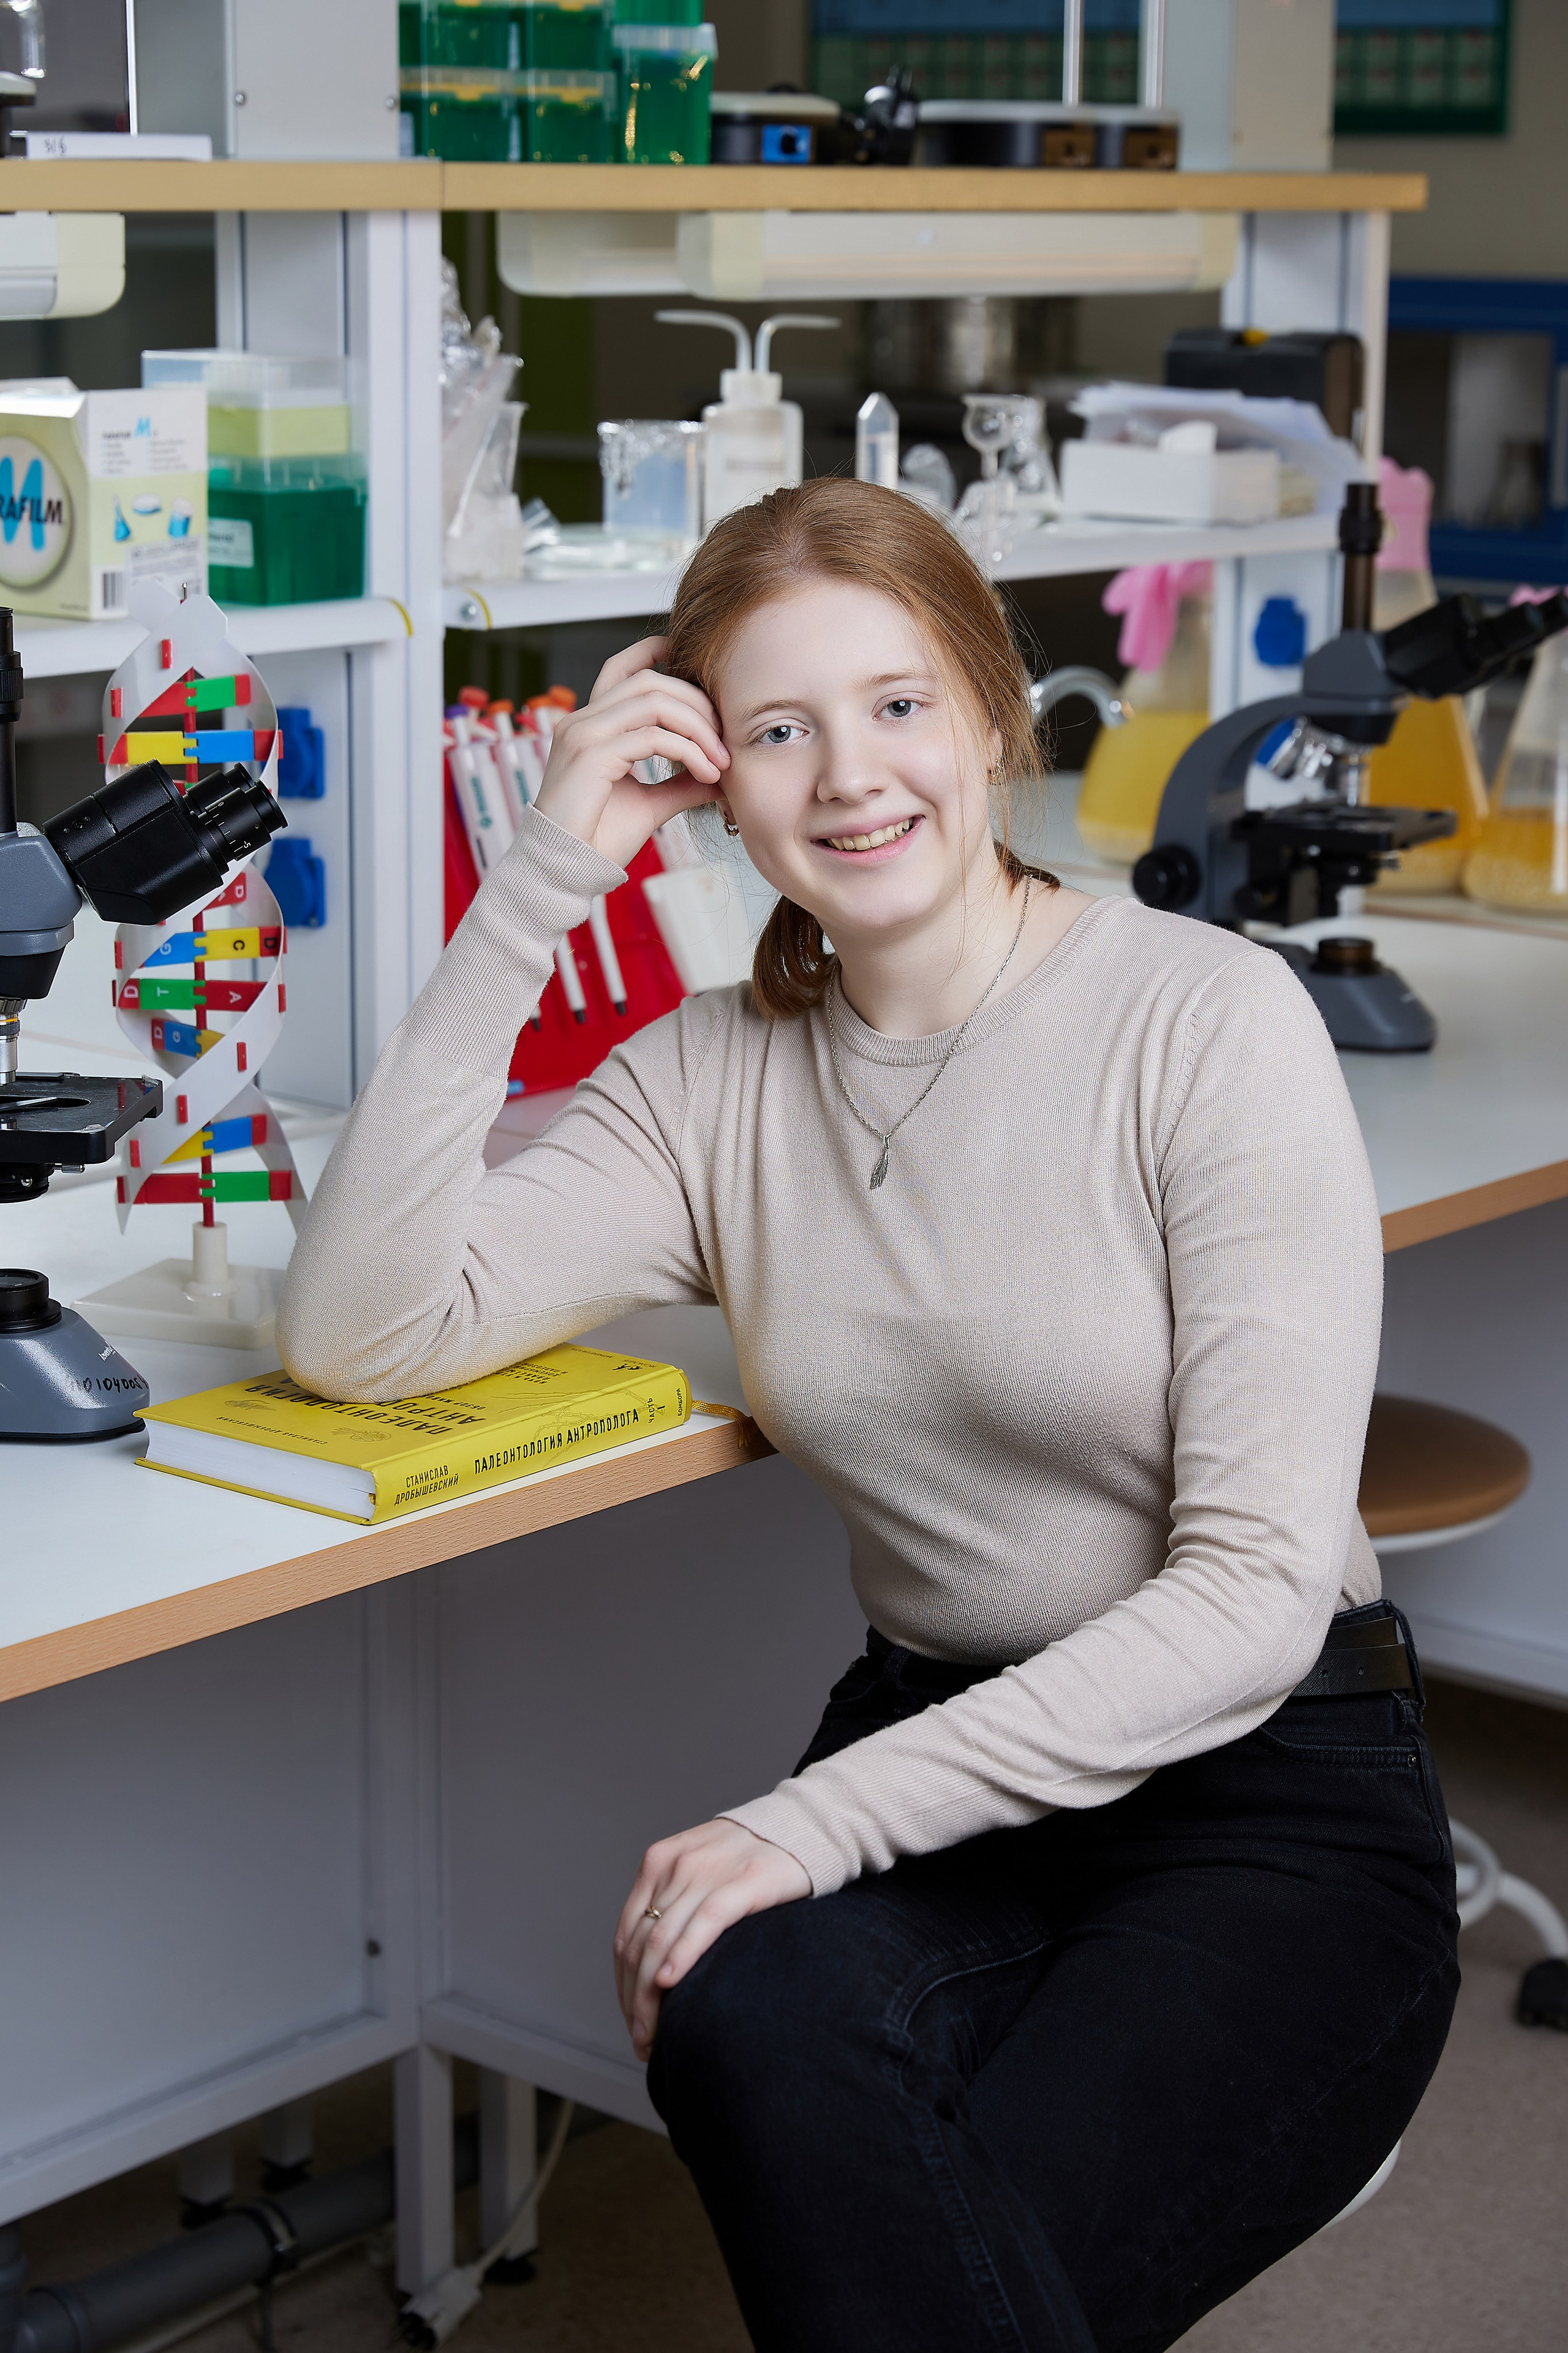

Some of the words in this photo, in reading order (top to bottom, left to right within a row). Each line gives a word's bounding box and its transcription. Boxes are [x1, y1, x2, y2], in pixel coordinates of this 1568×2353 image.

[233, 940, 245, 951] C
[124, 986, 138, 998] D
[157, 987, 169, 997] T
[229, 991, 242, 1003] A
[244, 1384, 453, 1435] ПАЛЕОНТОЛОГИЯ
[216, 1416, 282, 1433] ДРОБЫШЕВСКИЙ
[282, 1432, 328, 1445] СТАНИСЛАВ
[474, 1433, 562, 1475] ПАЛЕОНТОЛОГИЯ
[566, 1408, 639, 1445] АНТРОПОЛОГА
[406, 1465, 449, 1488] СТАНИСЛАВ
[394, 1473, 459, 1506] ДРОБЫШЕВСКИЙ
